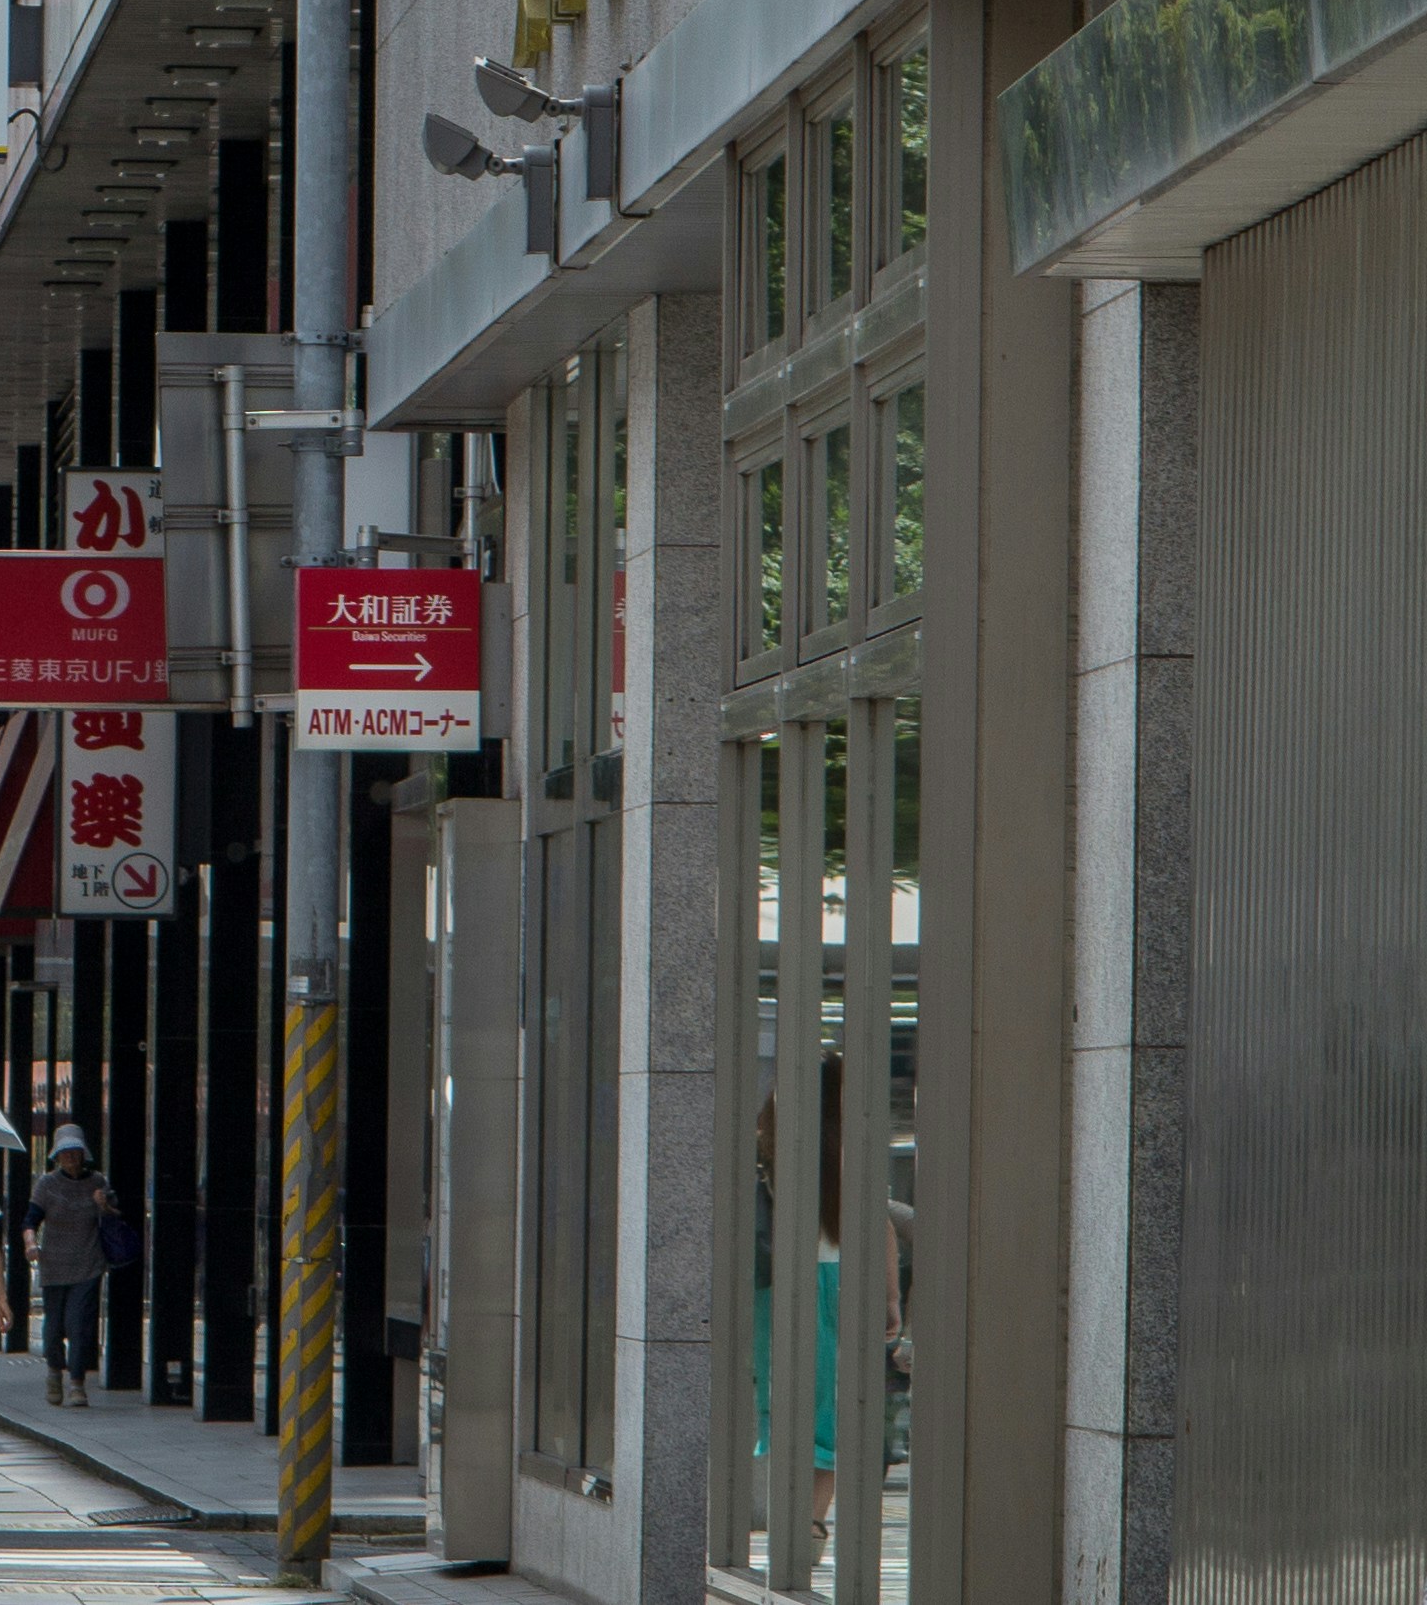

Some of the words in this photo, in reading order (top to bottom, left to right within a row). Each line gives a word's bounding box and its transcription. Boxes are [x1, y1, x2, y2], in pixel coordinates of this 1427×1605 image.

[327, 594, 454, 625] 大和証券
[72, 628, 119, 641] MUFG
[352, 630, 380, 642] Daiwa
[381, 630, 427, 643] Securities
